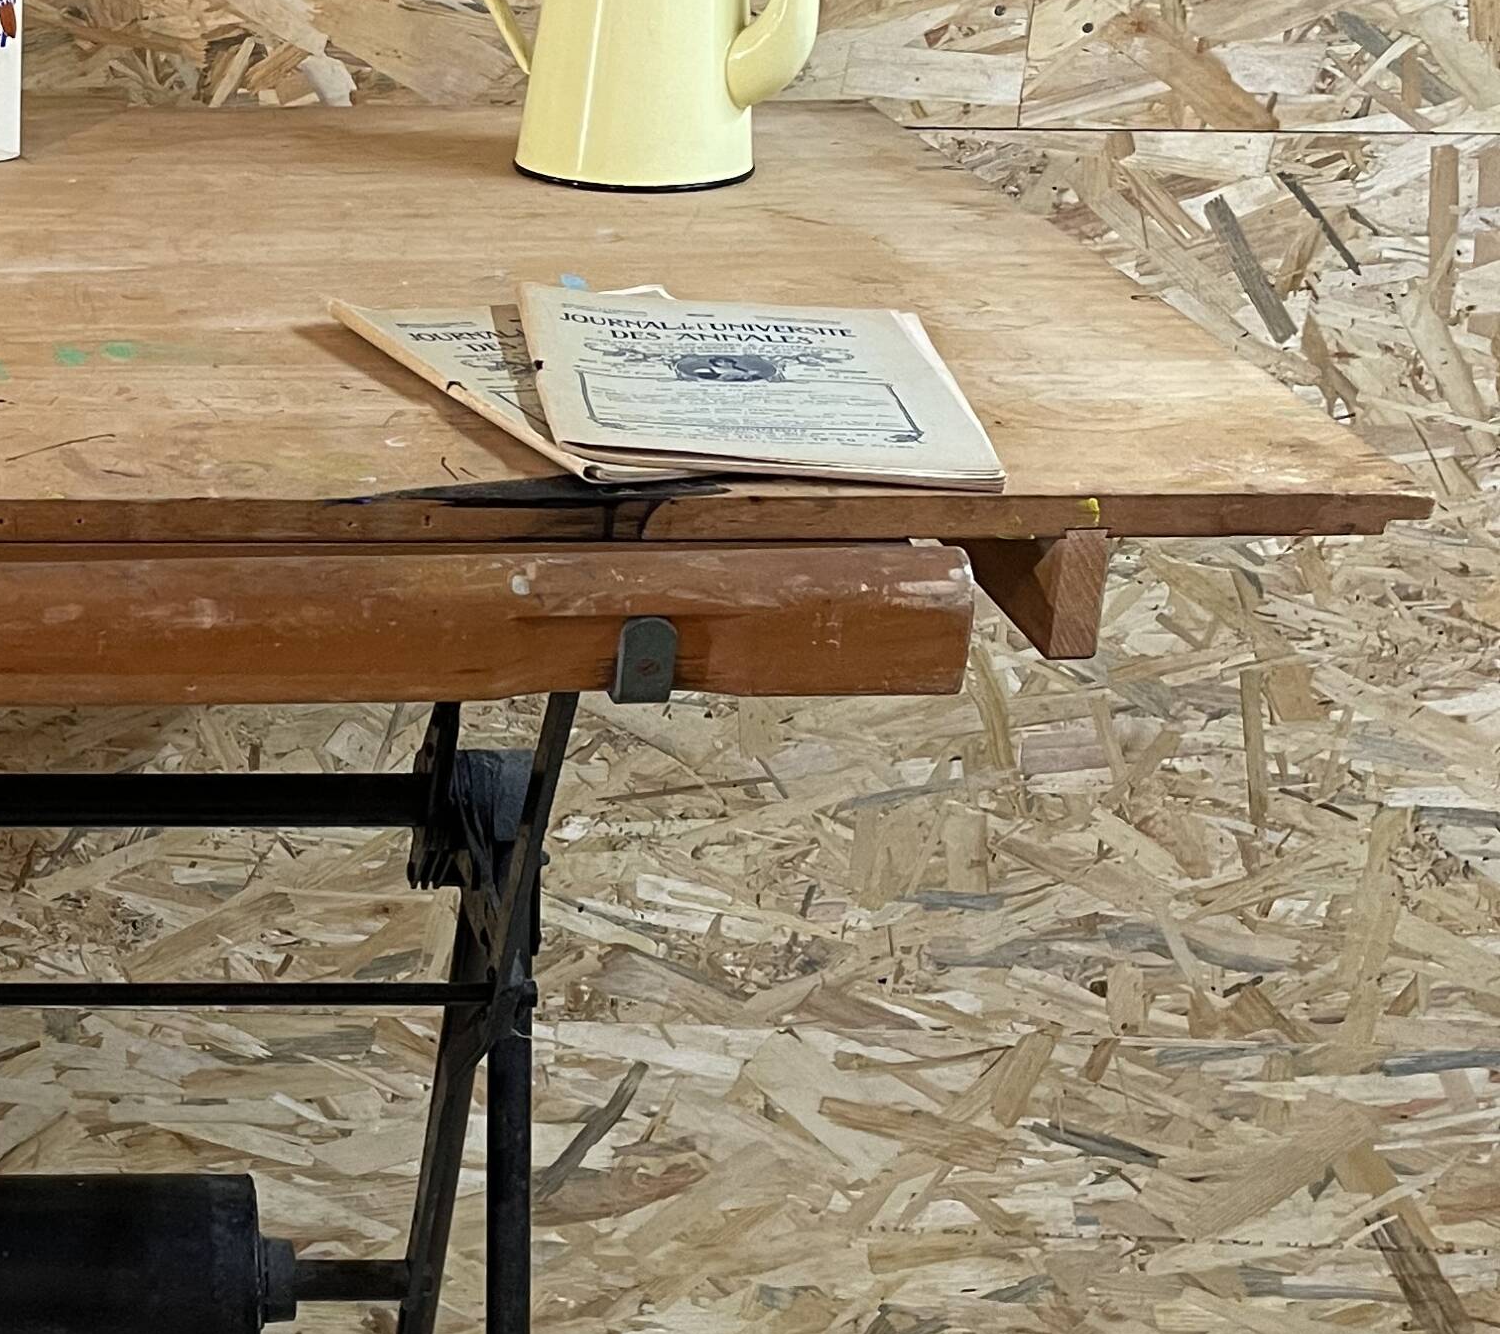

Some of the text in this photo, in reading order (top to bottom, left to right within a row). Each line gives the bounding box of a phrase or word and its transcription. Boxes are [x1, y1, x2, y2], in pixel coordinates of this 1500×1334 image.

[560, 312, 677, 331] JOURNAL
[611, 329, 813, 345] DES ANNALES
